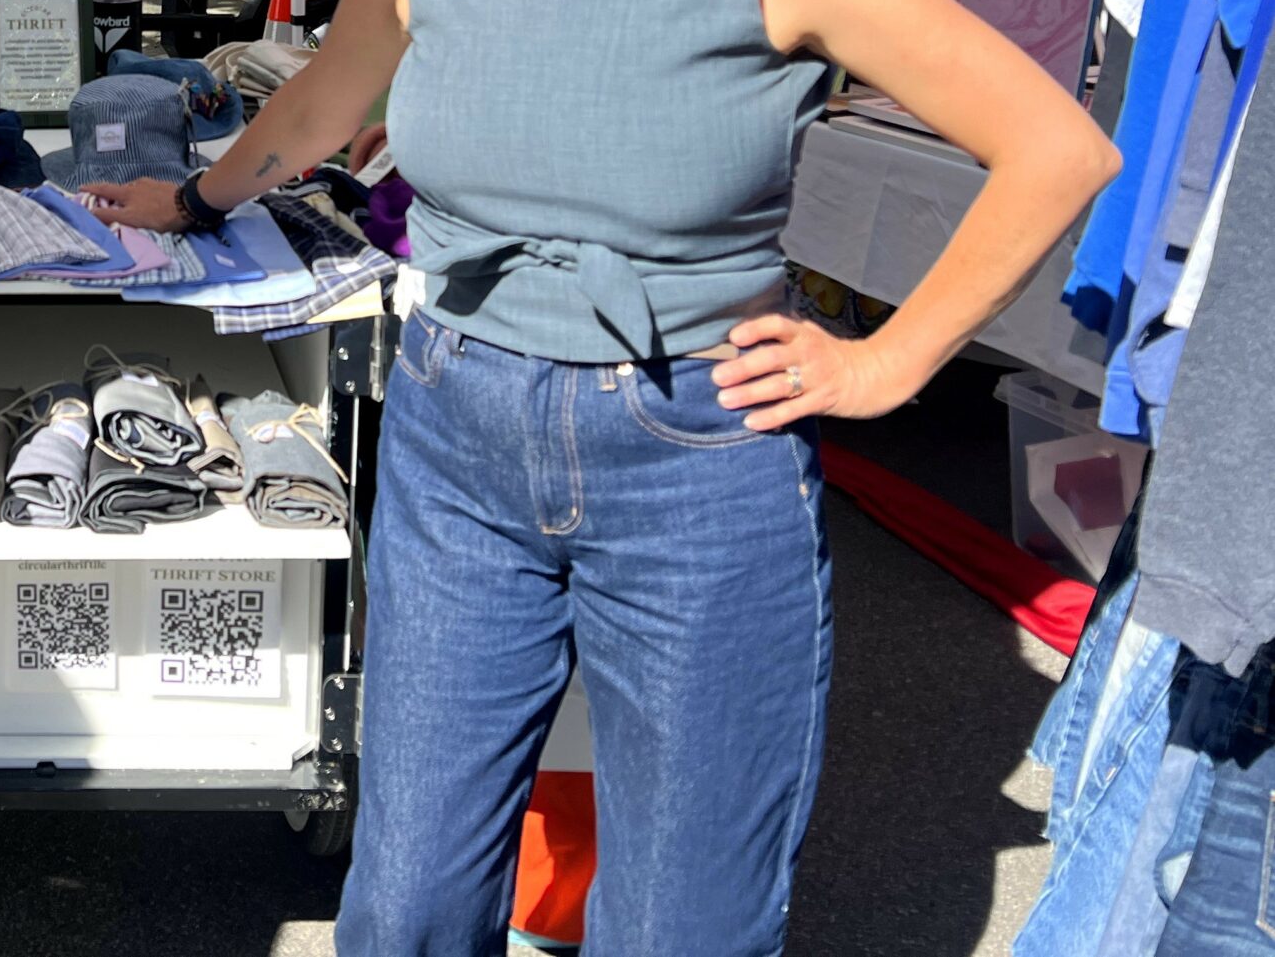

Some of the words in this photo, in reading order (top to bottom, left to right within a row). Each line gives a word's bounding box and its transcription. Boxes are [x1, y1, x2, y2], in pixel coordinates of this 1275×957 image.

[6, 18, 67, 30] THRIFT
[93, 15, 131, 27] owbird
[150, 568, 216, 581] THRIFT
[217, 569, 277, 583] STORE
